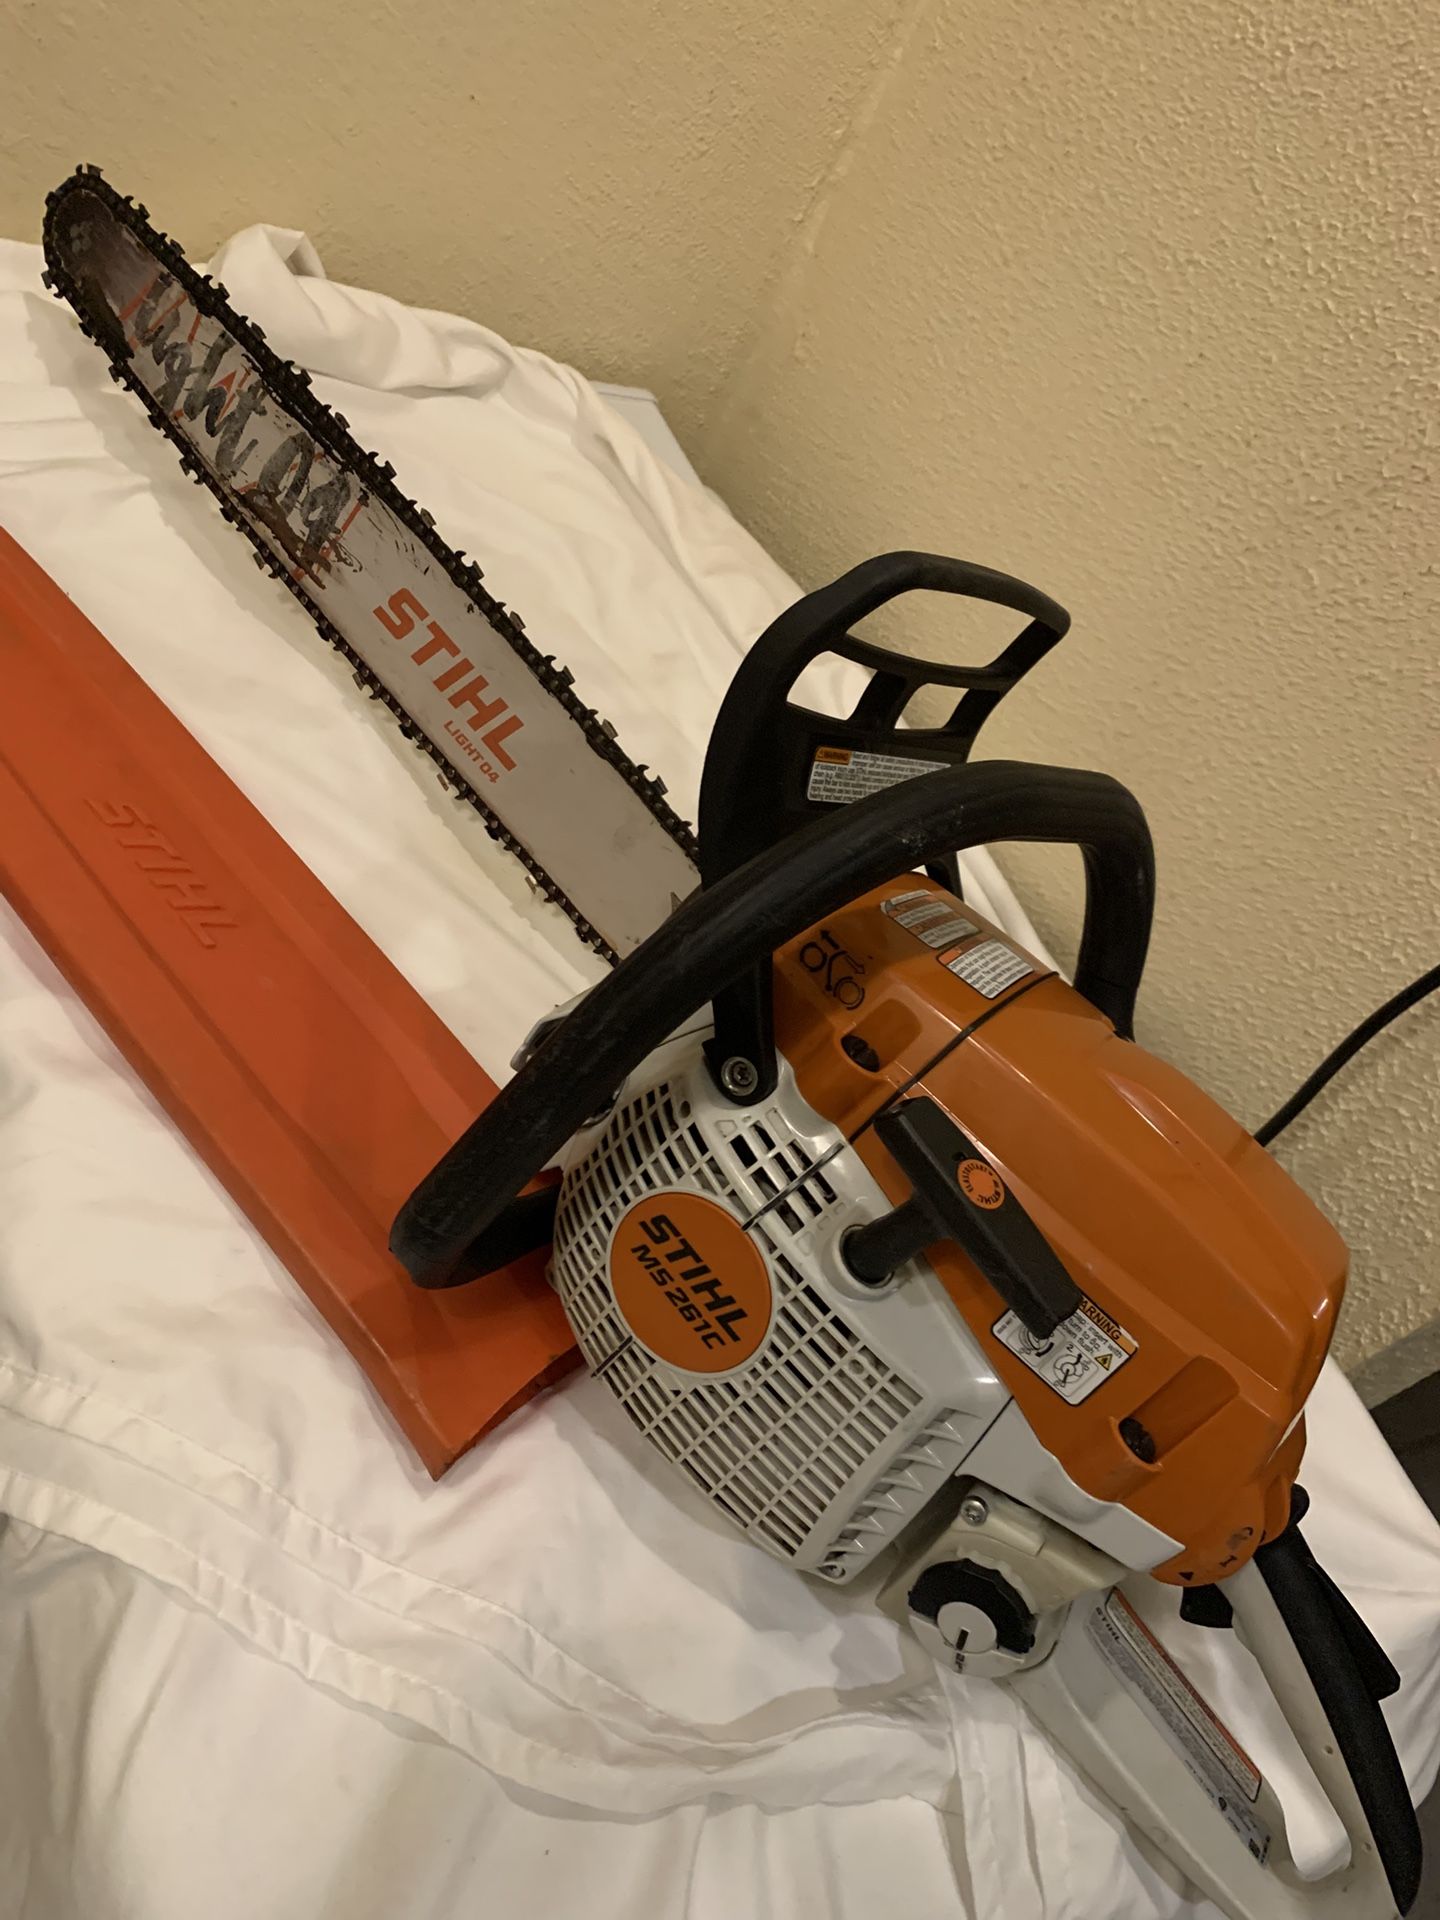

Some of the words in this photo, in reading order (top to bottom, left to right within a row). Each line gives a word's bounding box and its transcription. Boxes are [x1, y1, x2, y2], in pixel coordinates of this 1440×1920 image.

[372, 587, 525, 772] STIHL
[83, 798, 239, 950] STIHL
[638, 1213, 748, 1343] STIHL
[1079, 1296, 1122, 1340] ARNING
